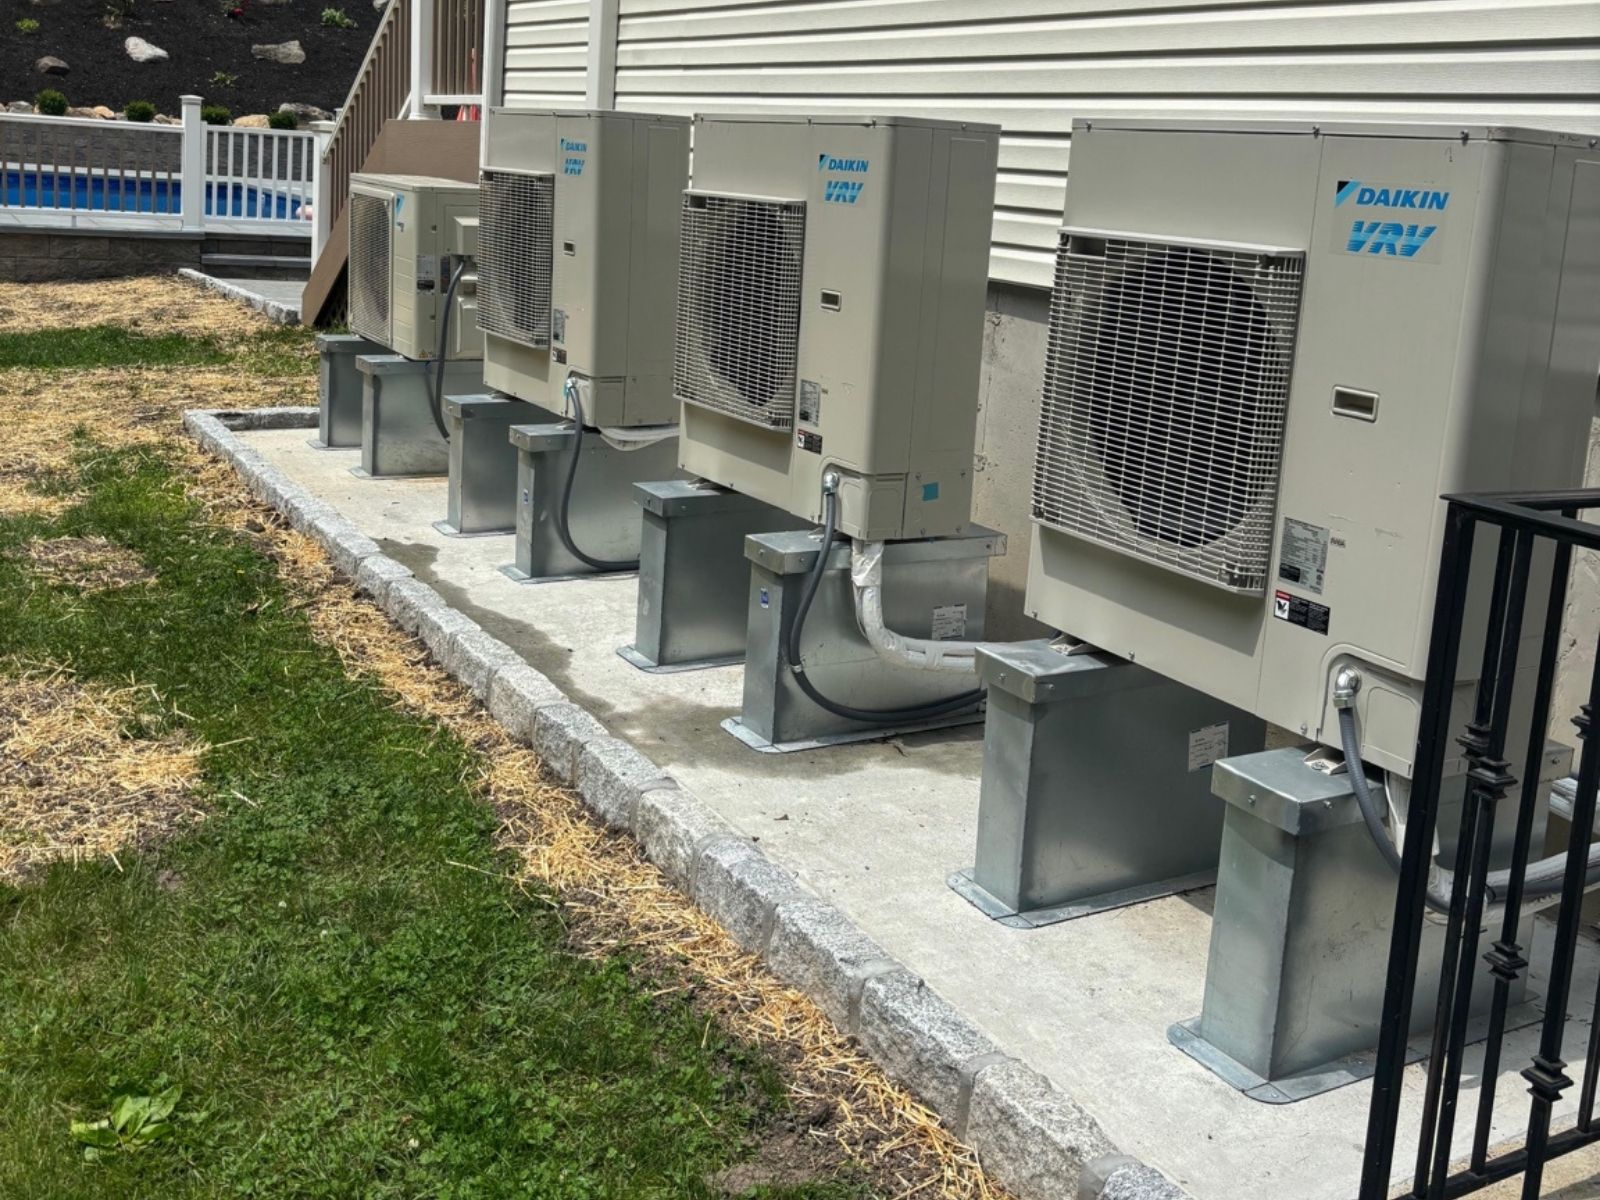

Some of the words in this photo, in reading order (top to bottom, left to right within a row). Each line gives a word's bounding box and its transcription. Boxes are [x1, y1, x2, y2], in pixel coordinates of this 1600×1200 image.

[828, 159, 869, 172] DAIKIN
[825, 180, 864, 203] VRV
[1356, 187, 1450, 210] DAIKIN
[1346, 220, 1437, 257] VRV
